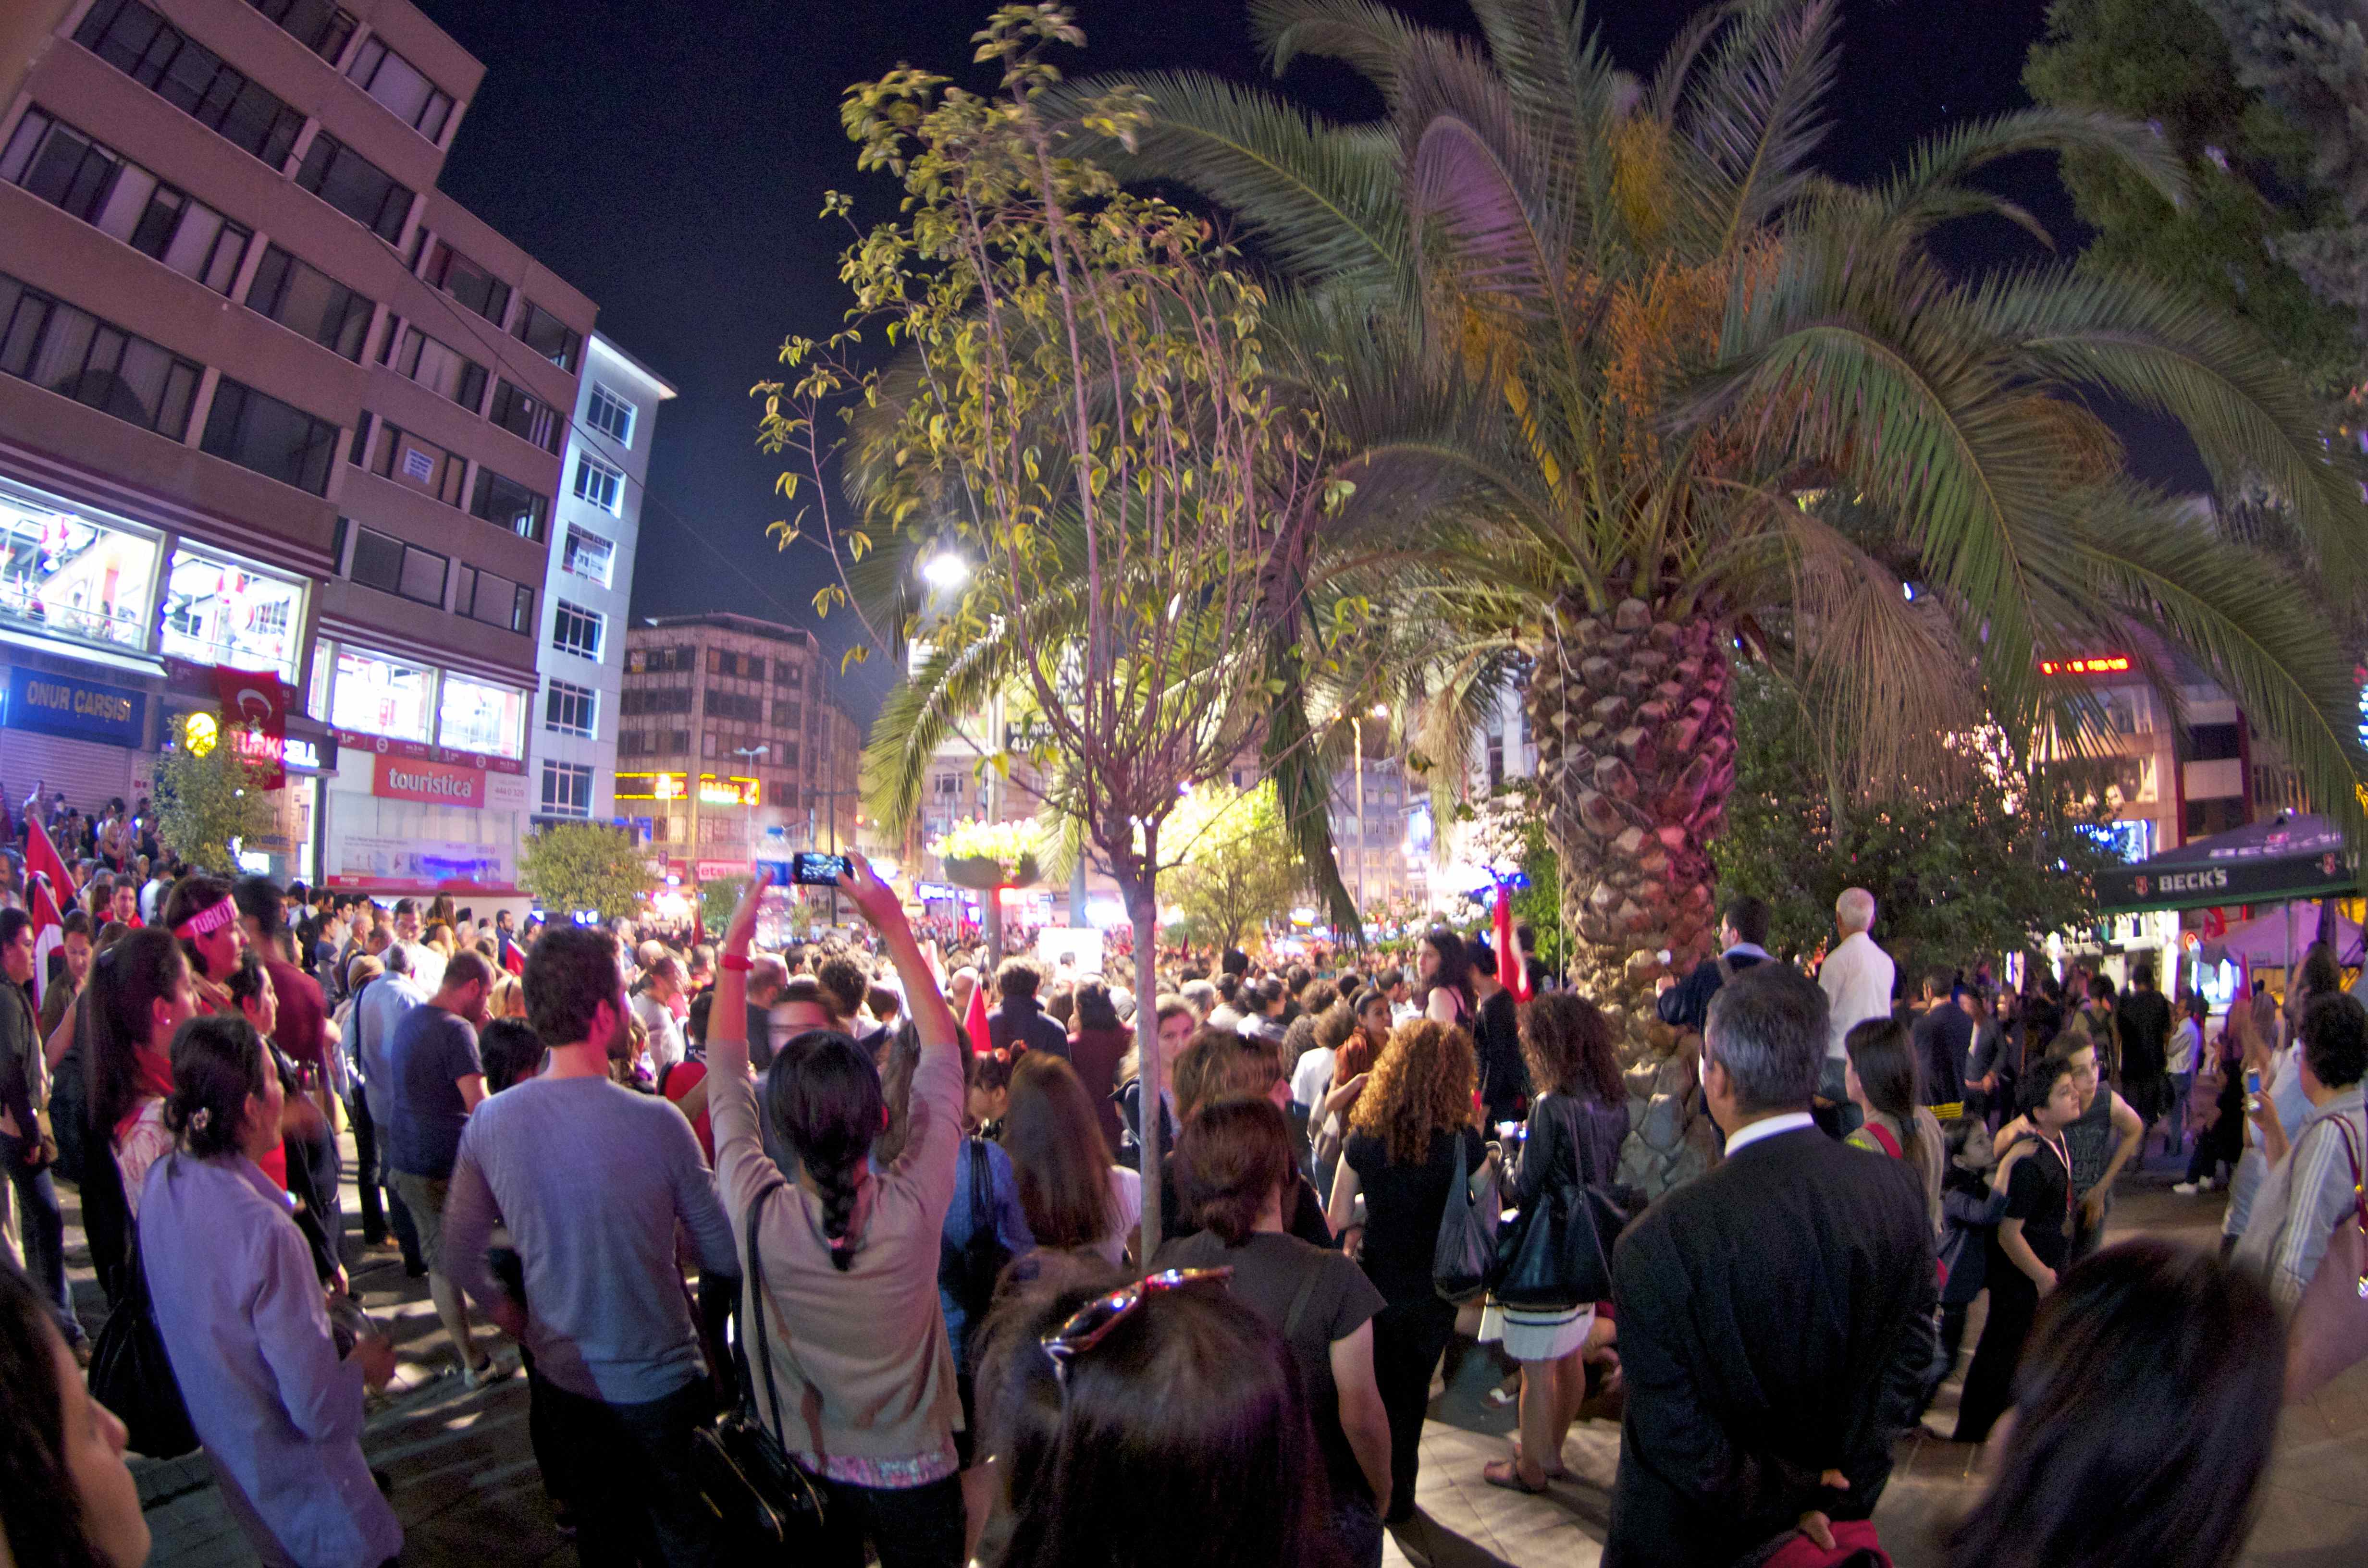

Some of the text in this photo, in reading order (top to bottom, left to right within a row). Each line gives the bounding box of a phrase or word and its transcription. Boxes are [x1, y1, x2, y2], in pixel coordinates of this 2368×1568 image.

[26, 680, 131, 723] ONUR ÇARŞISI
[389, 768, 472, 798] touristica
[2158, 867, 2228, 893] BECK'S
